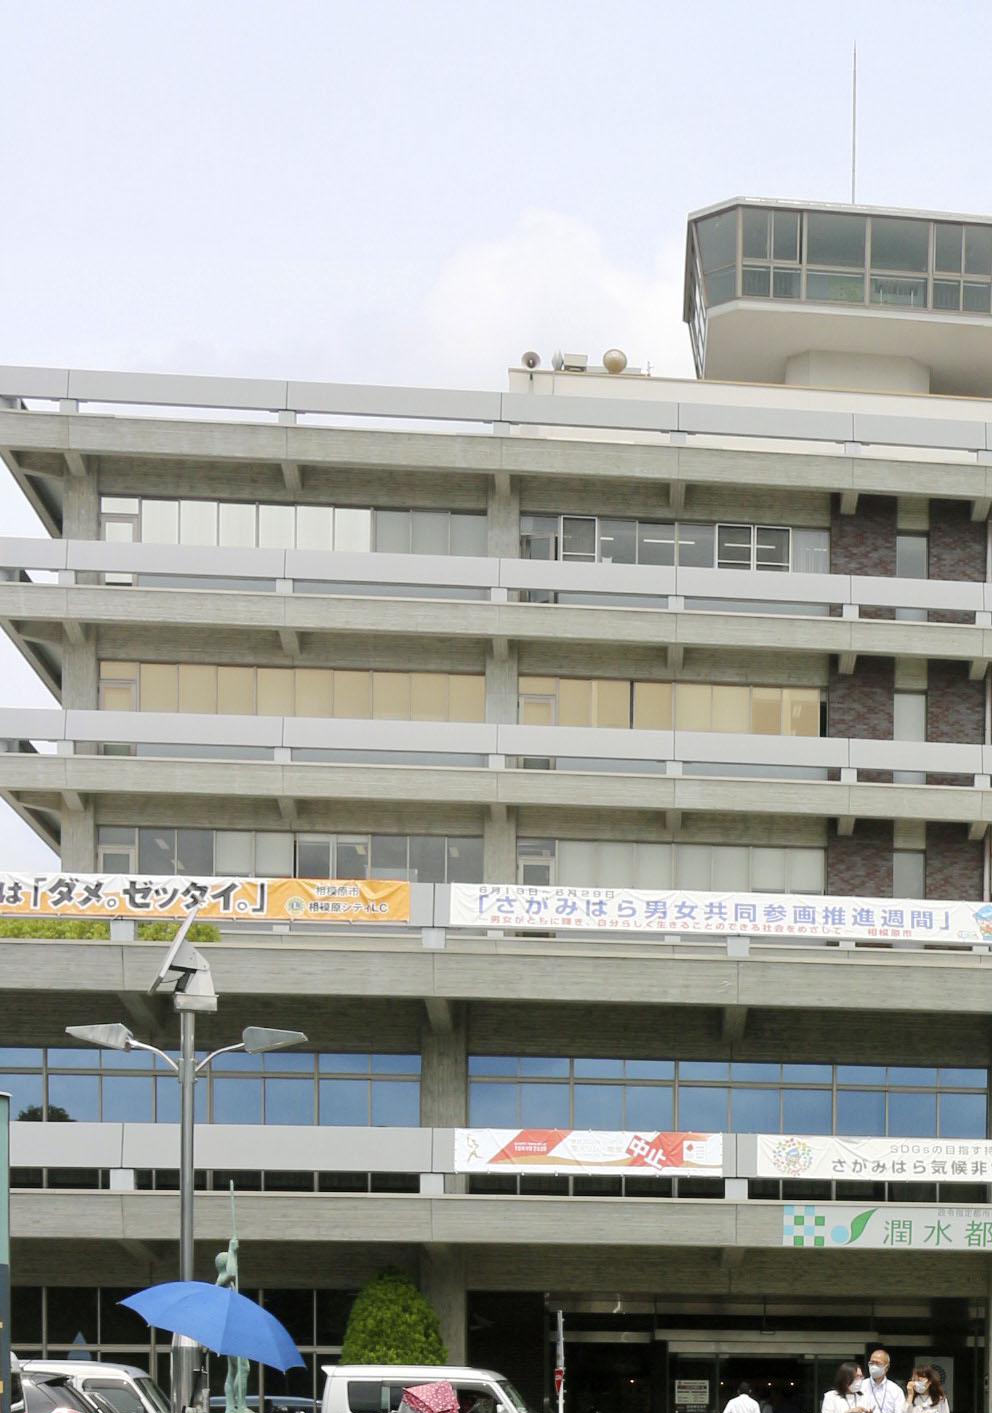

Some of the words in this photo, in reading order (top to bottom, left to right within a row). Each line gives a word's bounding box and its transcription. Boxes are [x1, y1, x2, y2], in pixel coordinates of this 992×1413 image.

[315, 885, 360, 897] 相模原市
[478, 894, 949, 931] 「さがみはら男女共同参画推進週間」
[867, 927, 913, 938] 相模原市
[629, 1138, 667, 1169] 中止
